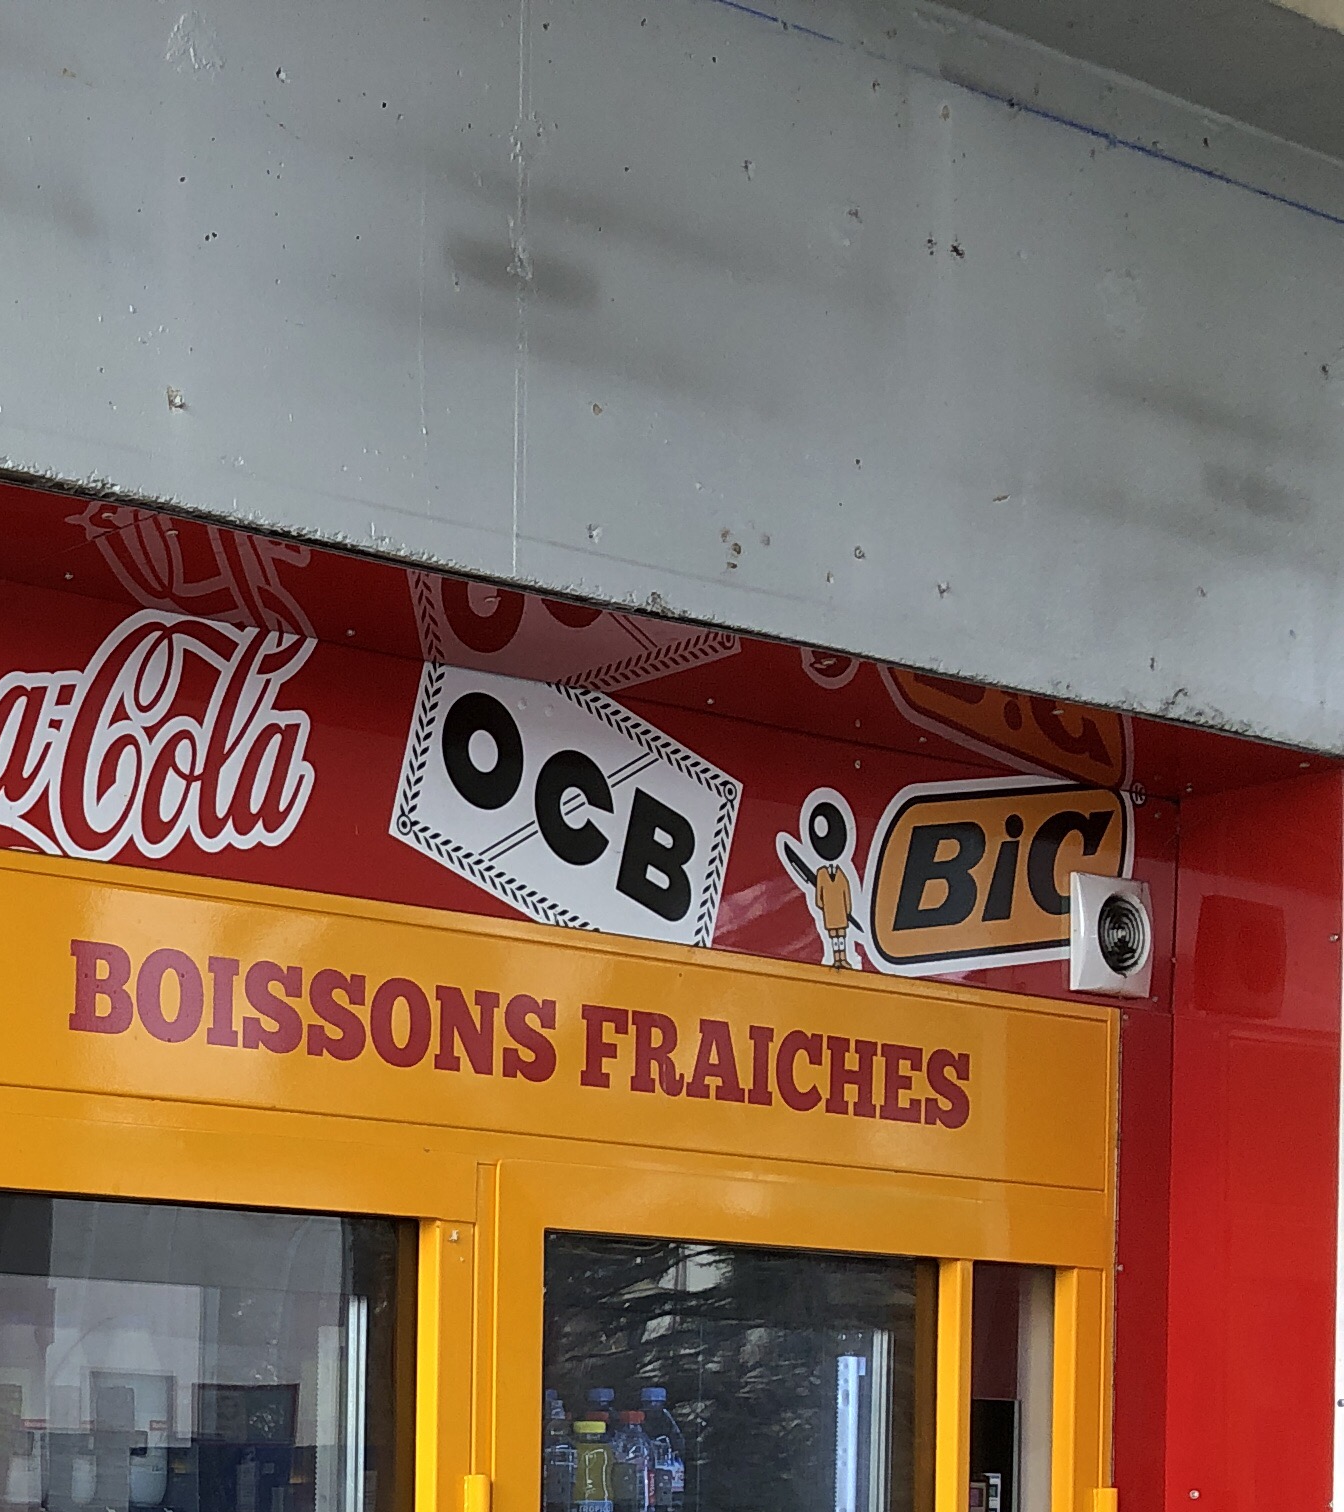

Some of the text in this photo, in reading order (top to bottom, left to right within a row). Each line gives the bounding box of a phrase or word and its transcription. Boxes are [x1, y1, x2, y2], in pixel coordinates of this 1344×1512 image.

[442, 692, 696, 924] OCB
[68, 940, 971, 1131] BOISSONS FRAICHES
